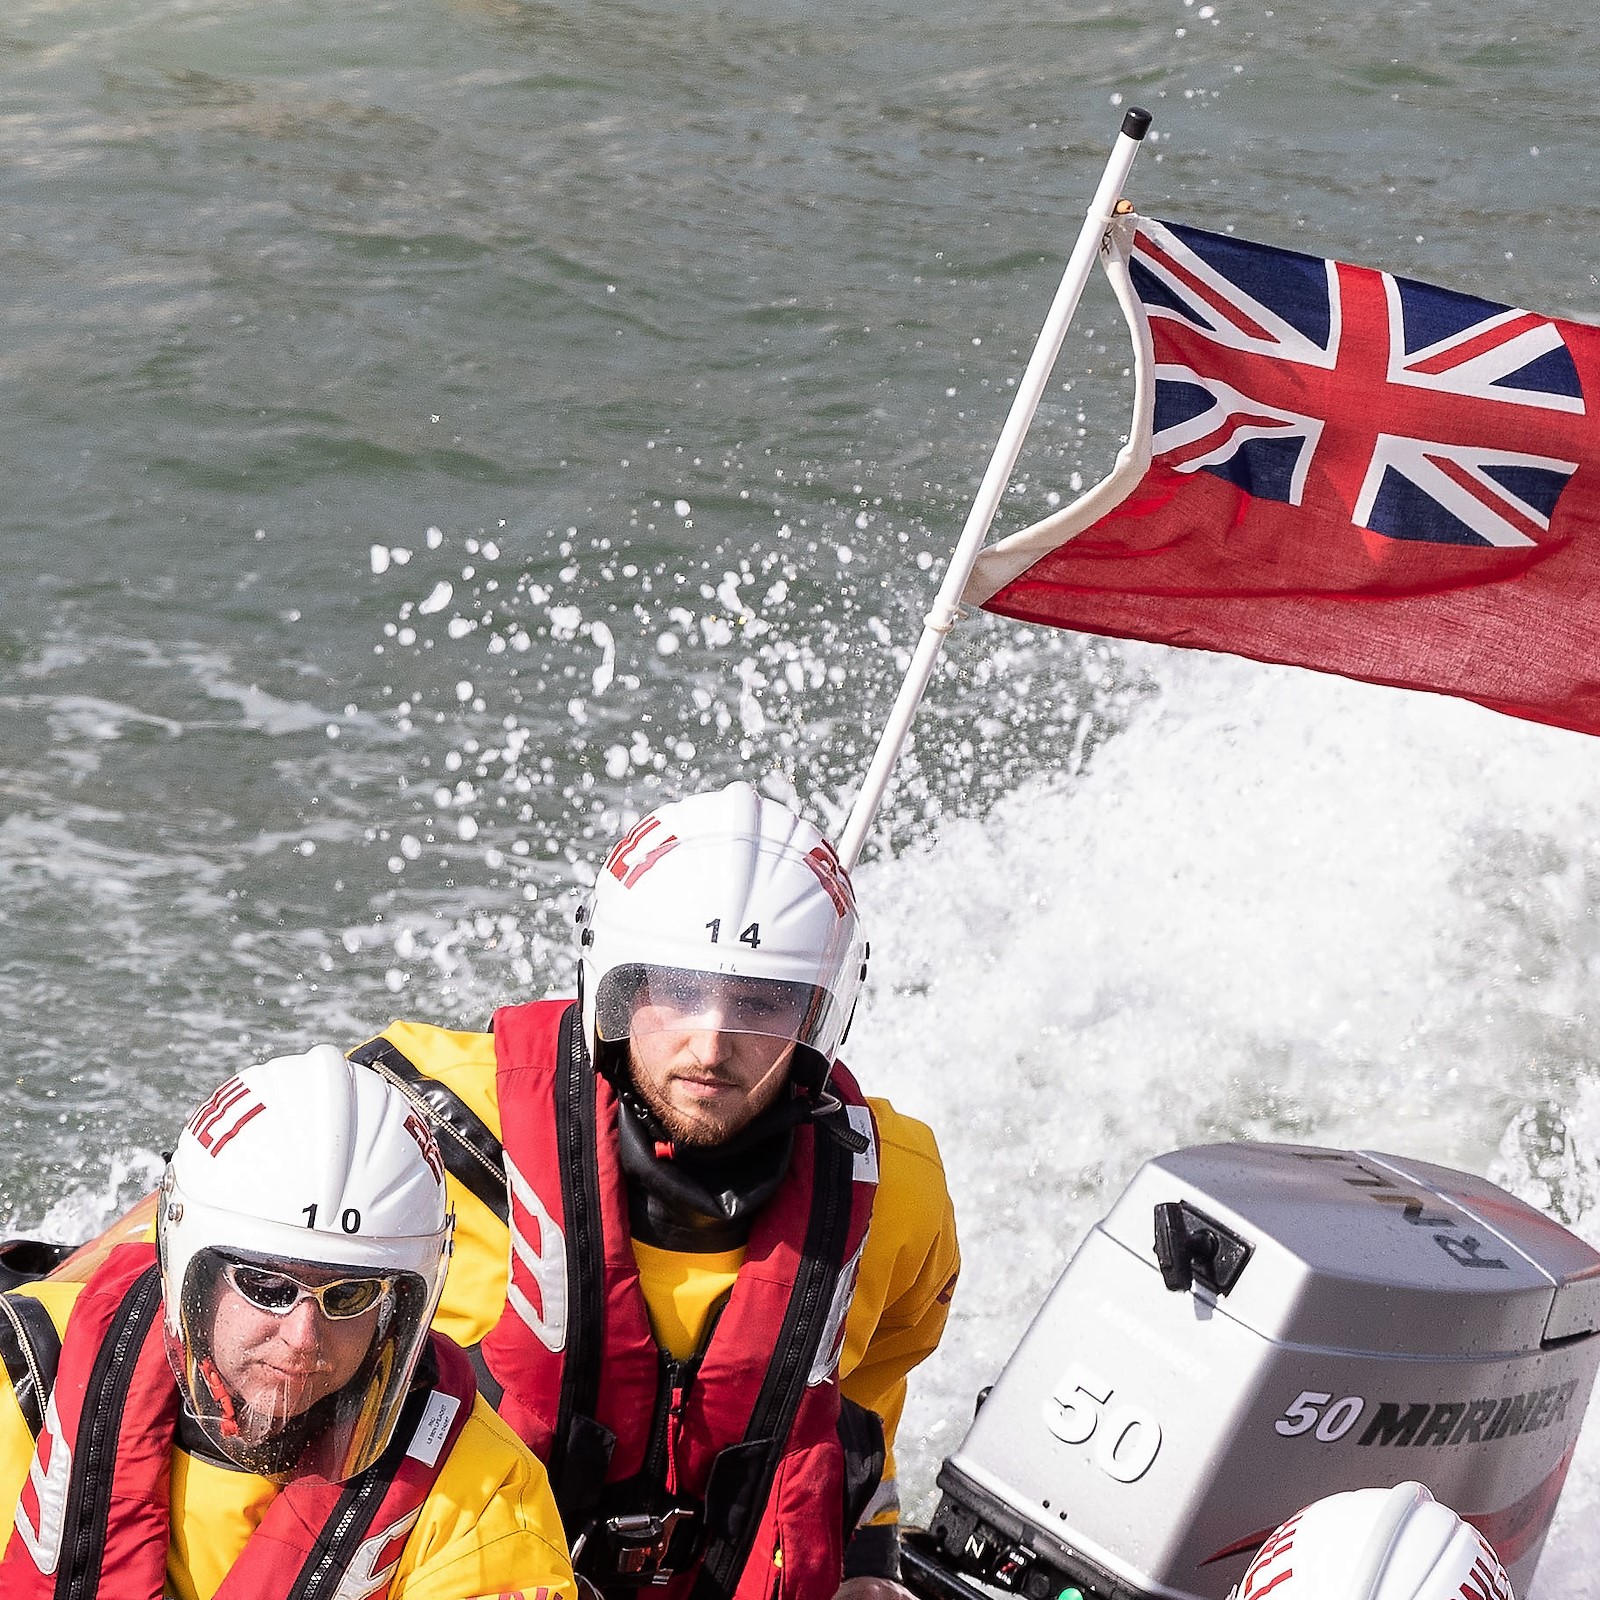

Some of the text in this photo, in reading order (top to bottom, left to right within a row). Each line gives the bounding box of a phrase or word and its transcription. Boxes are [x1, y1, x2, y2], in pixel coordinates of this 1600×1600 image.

[705, 918, 761, 949] 14
[301, 1203, 362, 1235] 10
[1042, 1361, 1163, 1485] 50
[1274, 1378, 1580, 1447] 50 MARINER
